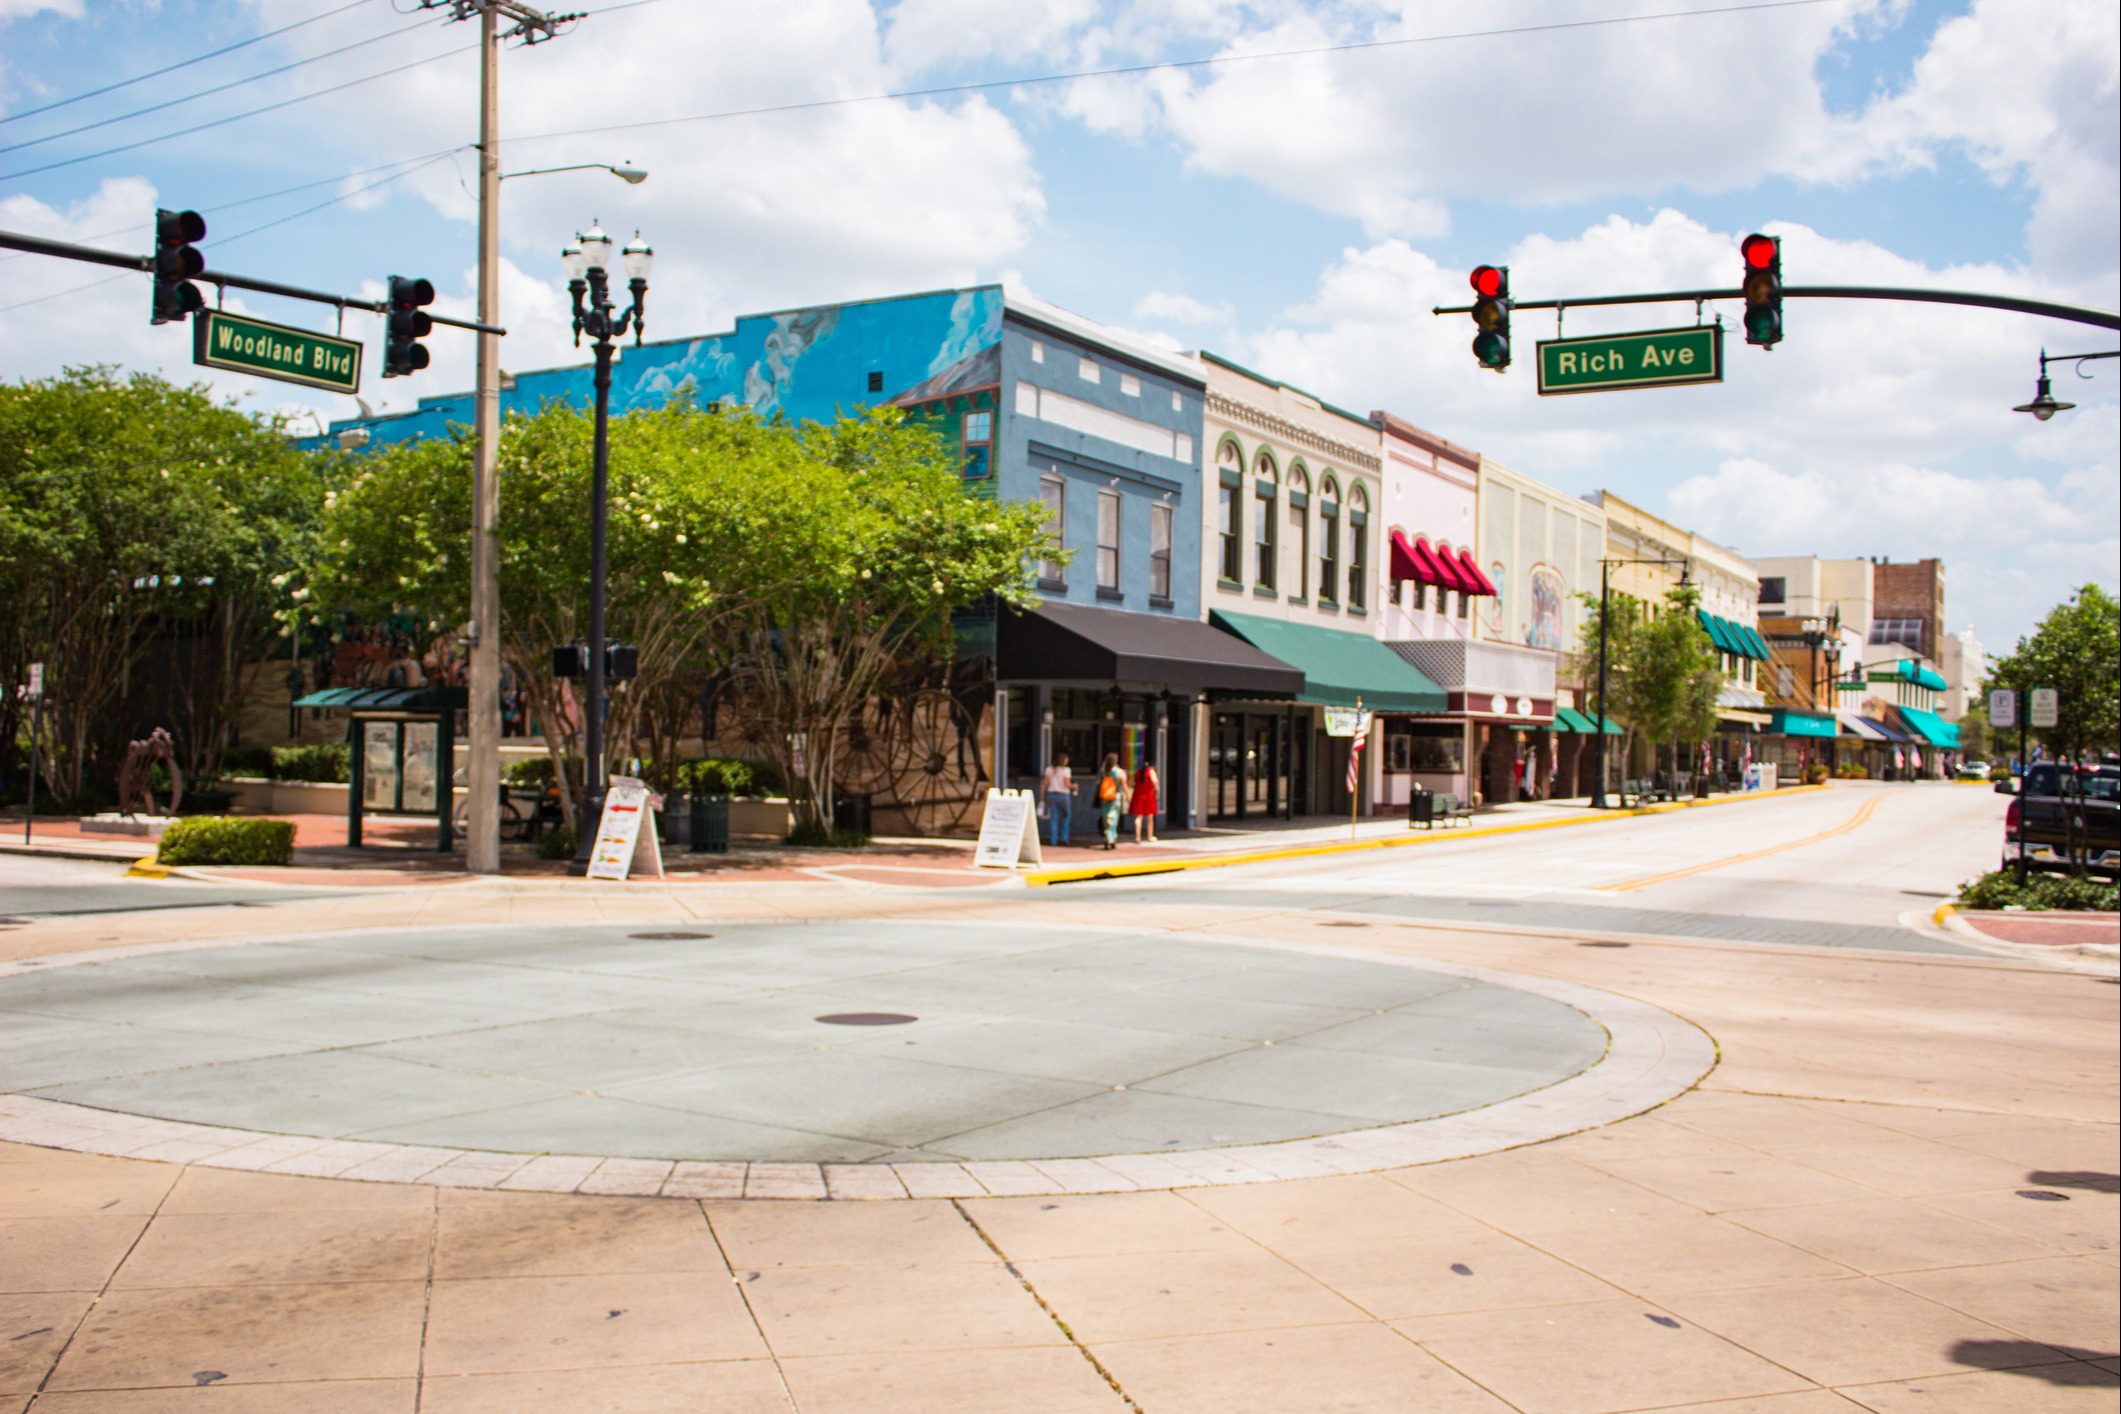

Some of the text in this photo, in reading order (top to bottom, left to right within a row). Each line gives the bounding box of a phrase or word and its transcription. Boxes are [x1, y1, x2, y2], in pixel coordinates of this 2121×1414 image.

[218, 325, 350, 375] Woodland Blvd
[1559, 344, 1695, 375] Rich Ave
